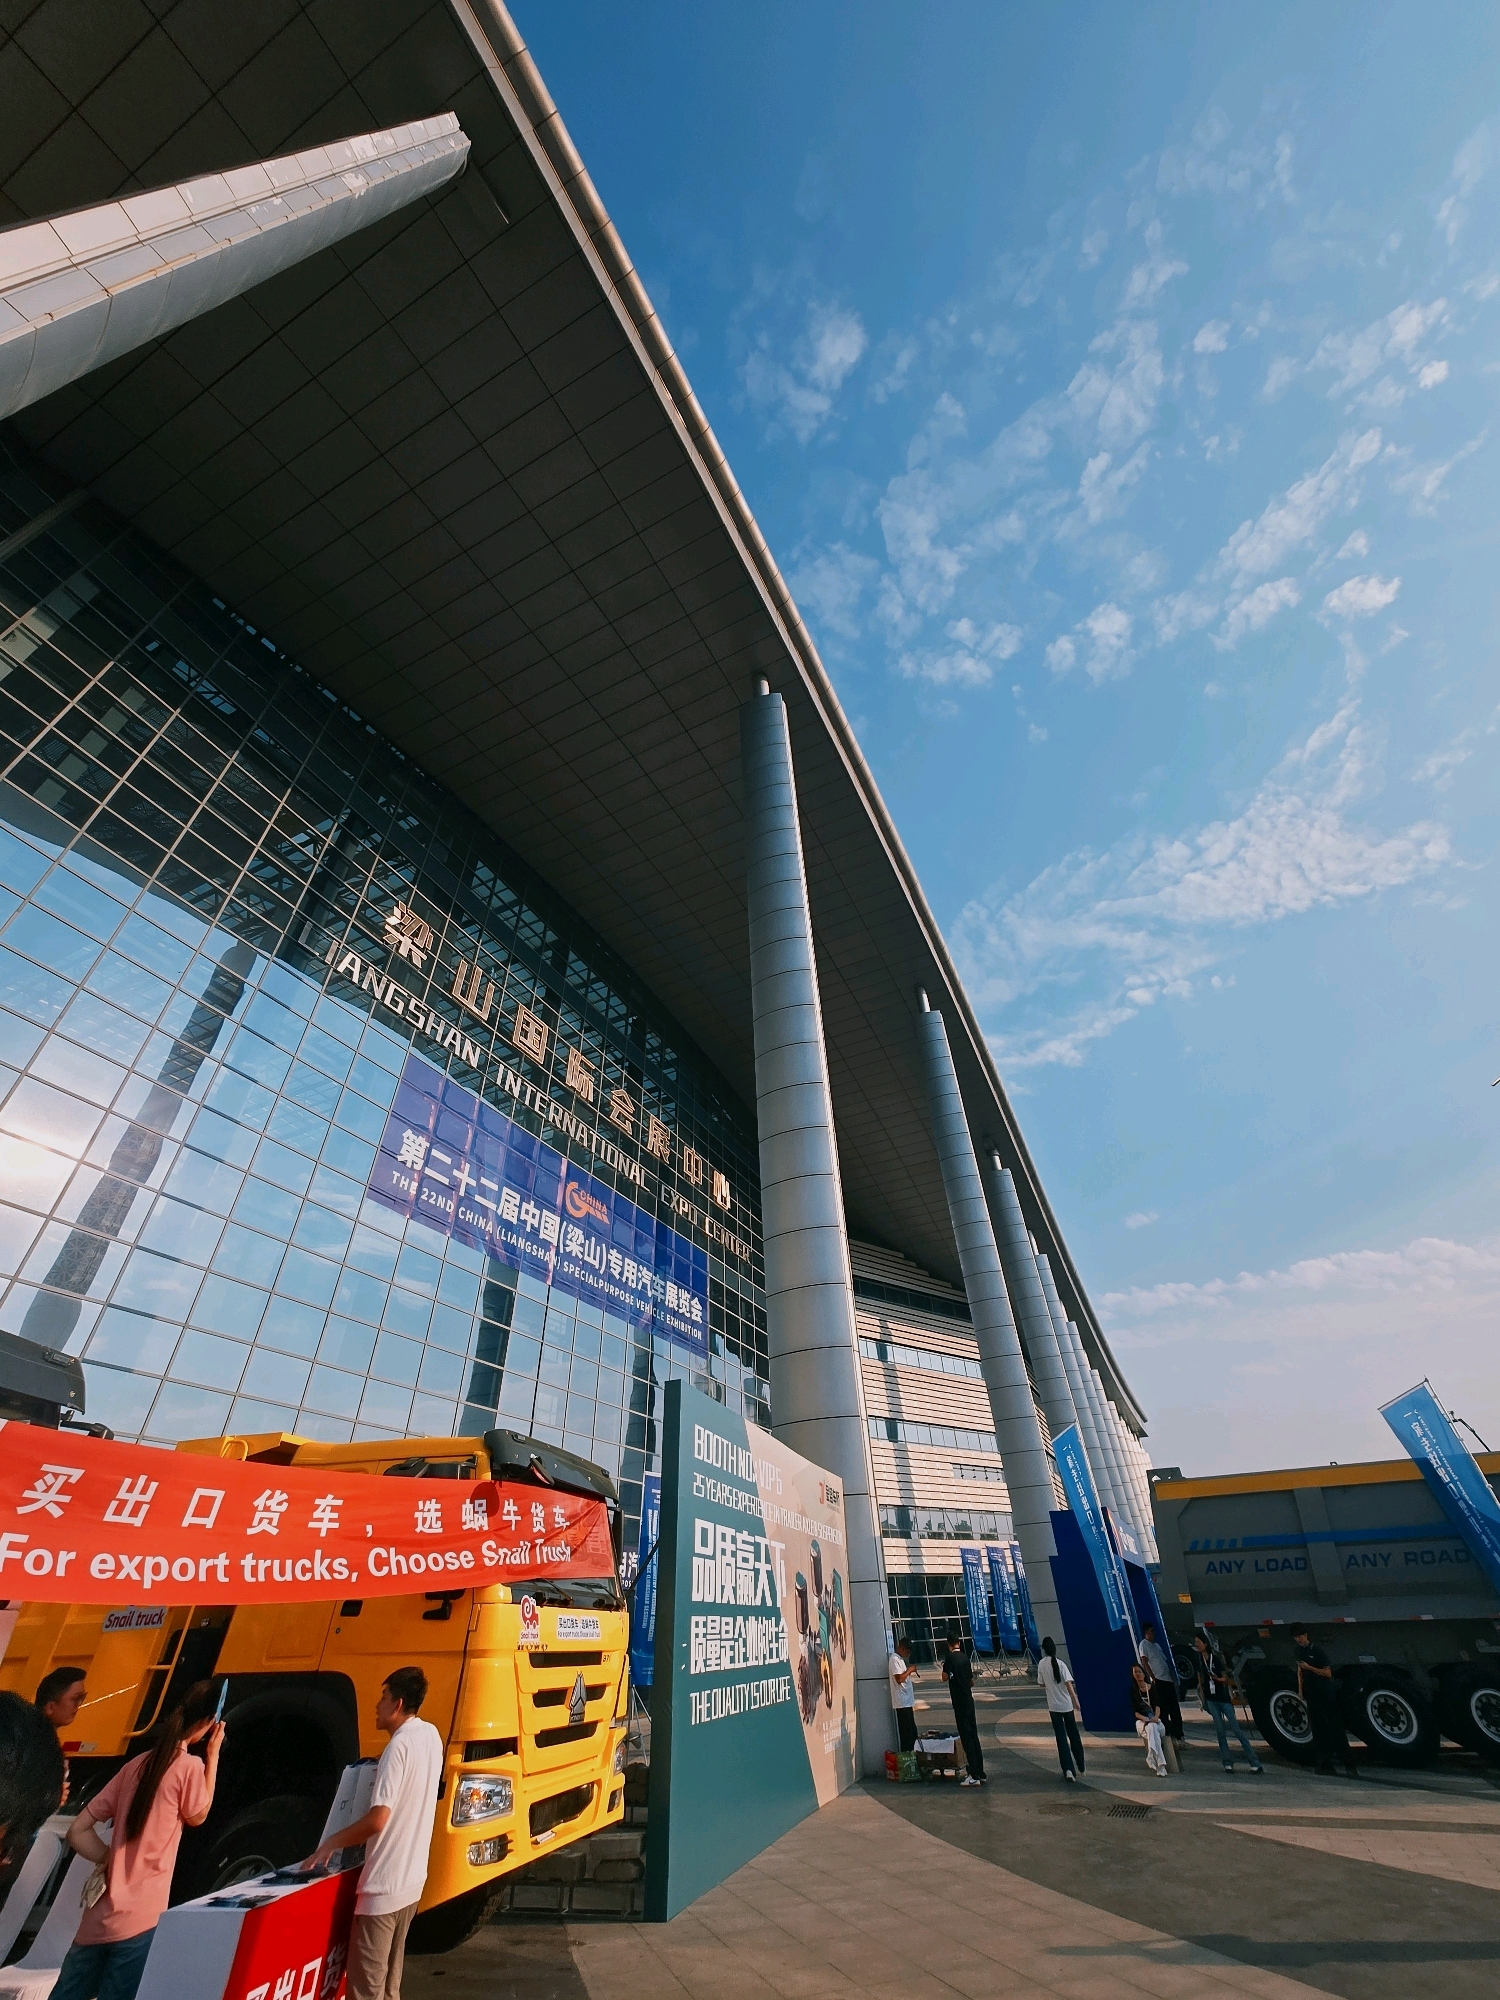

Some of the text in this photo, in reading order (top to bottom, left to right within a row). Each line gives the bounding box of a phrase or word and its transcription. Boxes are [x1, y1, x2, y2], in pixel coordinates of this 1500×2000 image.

[382, 901, 732, 1211] 梁山国际会展中心
[298, 920, 751, 1264] LIANGSHAN INTERNATIONAL EXPO CENTER
[396, 1129, 703, 1324] 第二十二届中国(梁山)专用汽车展览会
[580, 1190, 608, 1214] CHINA
[392, 1170, 419, 1195] THE
[420, 1187, 455, 1213] 22ND
[457, 1206, 494, 1234] CHINA
[496, 1225, 561, 1270] (LIANGSHAN)
[635, 1298, 665, 1322] VEHICLE
[666, 1314, 702, 1341] EXHIBITION
[694, 1423, 737, 1476] BOOTH
[16, 1463, 571, 1537] 买出口货车，选蜗牛货车
[693, 1471, 705, 1498] 25
[705, 1476, 733, 1508] YEARS
[732, 1488, 774, 1523] EXPERIENCE
[0, 1532, 571, 1589] For export trucks, Choose Snail Truck
[692, 1517, 787, 1608] 品质赢天下
[1205, 1549, 1471, 1576] ANY LOAD ANY ROAD
[104, 1608, 165, 1629] Snail truck
[690, 1615, 789, 1675] 质量是企业的生命
[690, 1675, 791, 1726] THE QUALITY IS OUR LIFE
